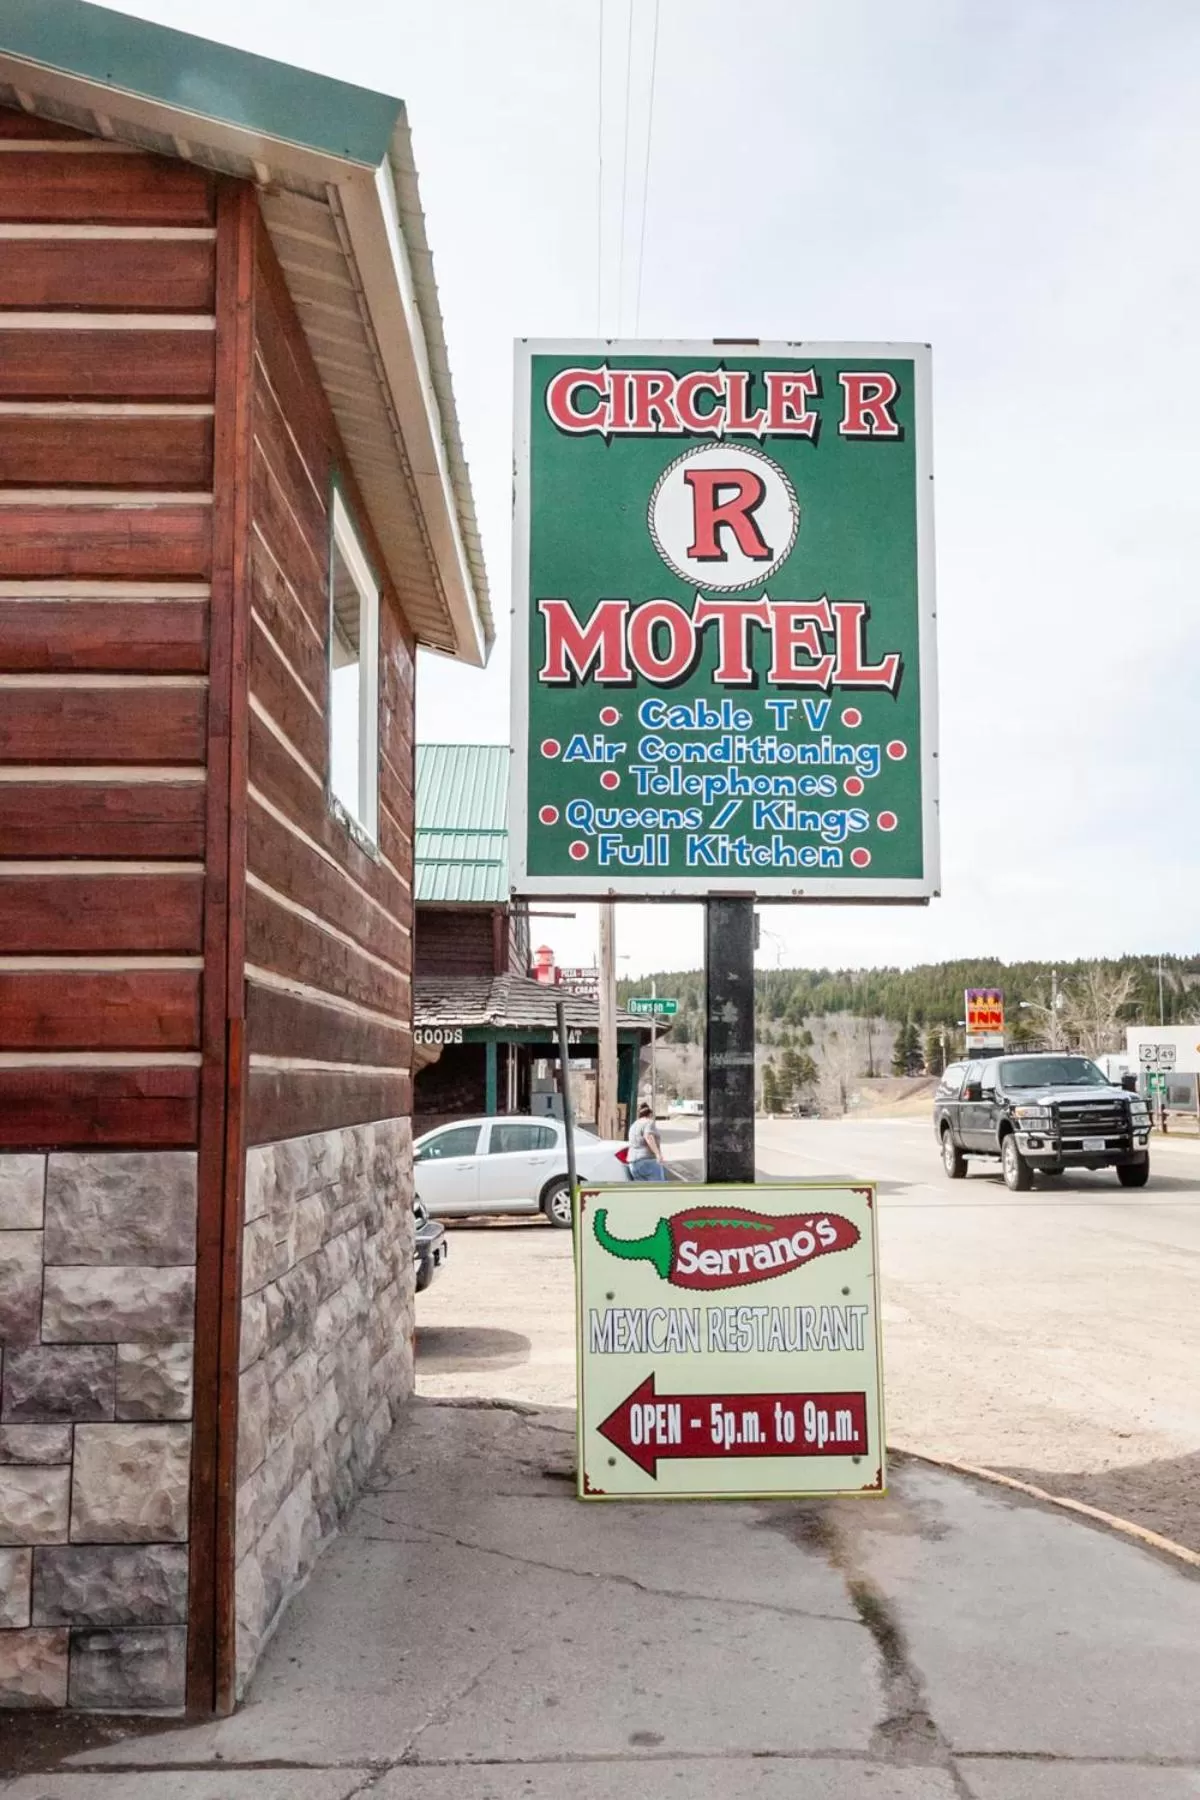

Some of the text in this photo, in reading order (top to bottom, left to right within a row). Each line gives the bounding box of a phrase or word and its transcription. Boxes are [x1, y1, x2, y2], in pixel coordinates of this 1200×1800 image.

[546, 363, 904, 443] CIRCLE R
[684, 468, 773, 561] R
[537, 593, 903, 692] MOTEL
[638, 699, 753, 730] Cable
[562, 734, 881, 777] Air Conditioning
[629, 766, 837, 805] Telephones
[566, 799, 703, 834] Queens
[753, 800, 869, 842] Kings
[597, 834, 843, 867] Full Kitchen
[413, 1028, 463, 1044] GOODS
[552, 1029, 582, 1044] MAT
[968, 1011, 1002, 1024] INN
[1144, 1048, 1152, 1058] 2
[1161, 1050, 1174, 1058] 49
[676, 1218, 837, 1275] Serrano's
[589, 1305, 868, 1354] MEXICAN RESTAURANT
[630, 1403, 681, 1445] OPEN
[711, 1402, 766, 1450] 5p.m.
[775, 1401, 795, 1443] to
[804, 1400, 859, 1449] 9p.m.
